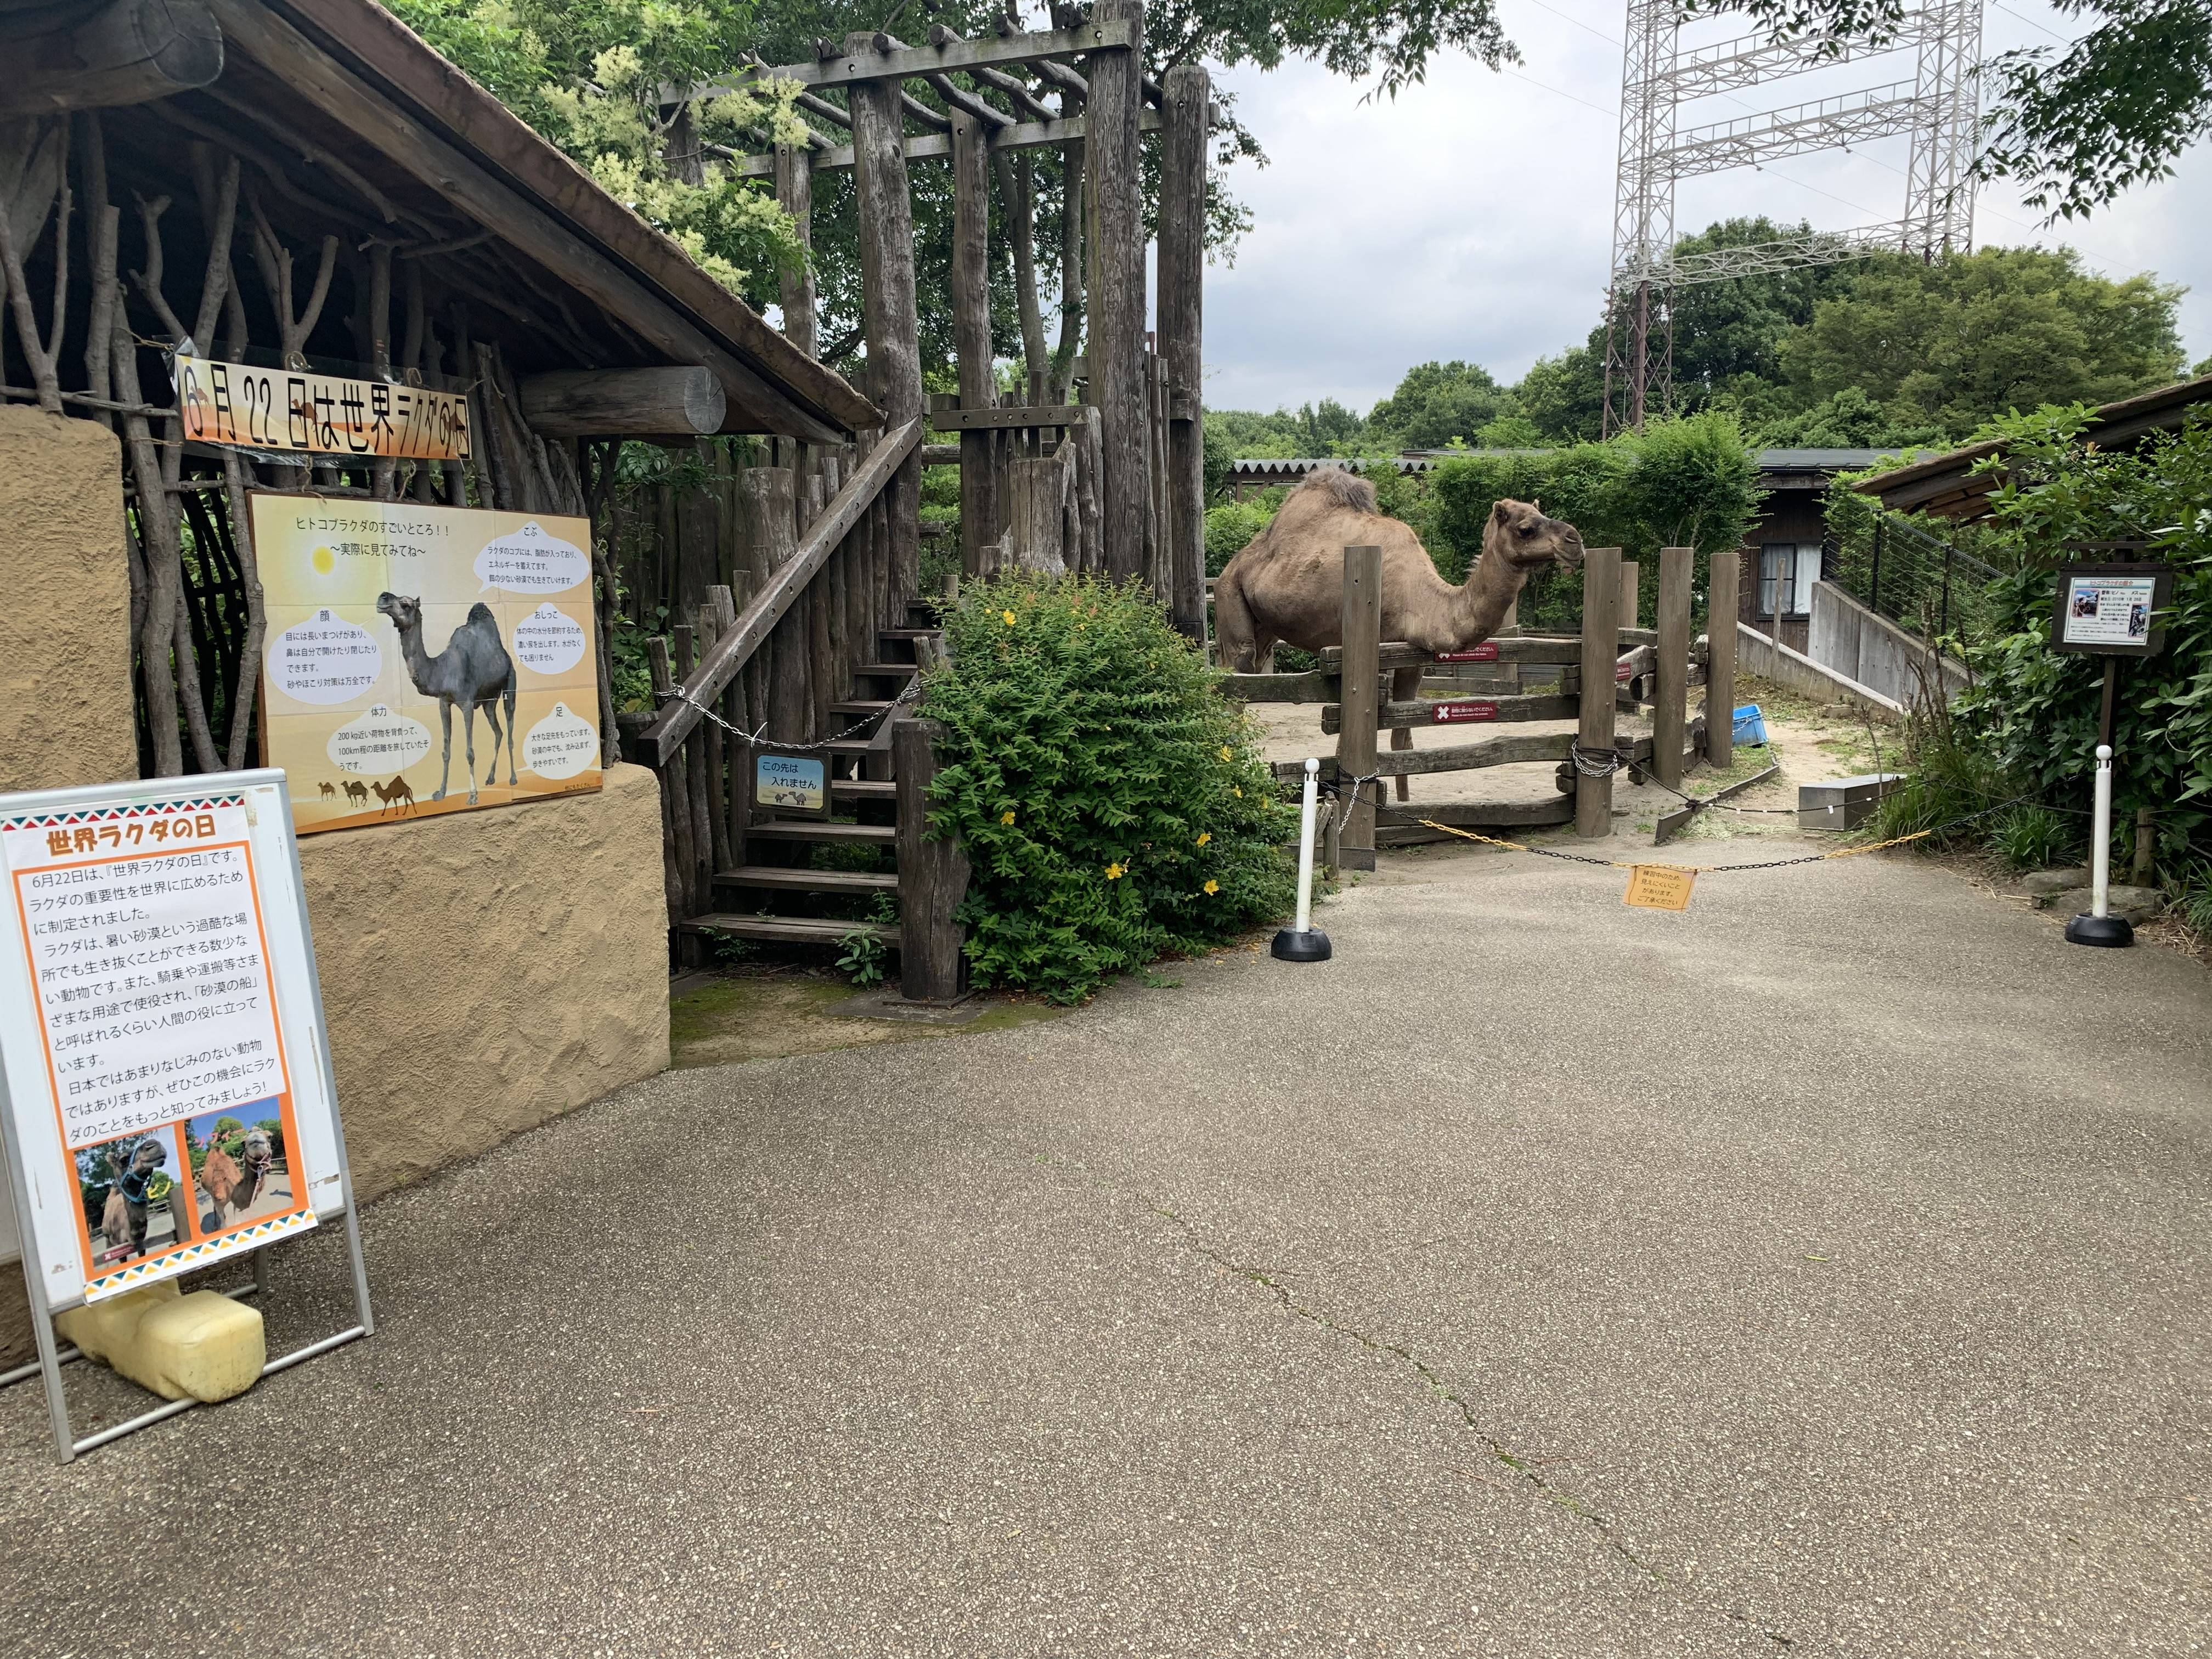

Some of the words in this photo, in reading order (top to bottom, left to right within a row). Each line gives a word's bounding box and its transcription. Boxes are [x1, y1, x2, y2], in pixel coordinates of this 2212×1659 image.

[184, 363, 470, 459] 6月22日は世界ラクダの日
[523, 527, 538, 537] こぶ
[320, 610, 330, 622] 顔
[534, 611, 558, 619] おしっこ
[286, 630, 366, 641] 目には長いまつげがあり、
[286, 645, 377, 658] 鼻は自分で開けたり閉じたり
[286, 663, 319, 673] できます。
[287, 675, 376, 690] 砂やほこり対策は万全です。
[371, 706, 387, 718] 体力
[556, 706, 563, 718] 足
[338, 740, 429, 755] 100km程の距離を旅していたそ
[339, 761, 363, 771] うです。
[763, 761, 799, 773] この先は
[771, 776, 817, 789] 入れません
[46, 814, 216, 857] 世界ラクダの日
[32, 849, 238, 889] 6月22日は、『世界ラクダの日』です。
[1643, 870, 1681, 881] 練習中のため、
[1641, 878, 1681, 889] 見えにくいこと
[29, 870, 244, 913] ラクダの重要性を世界に広めるため
[1642, 888, 1673, 897] があります。
[1638, 895, 1678, 905] ご了承ください
[33, 907, 151, 936] に制定されました。
[43, 912, 247, 958] ラクダは、暑い砂漠という過酷な場
[41, 934, 248, 983] 所でも生き抜くことができる数少な
[46, 952, 260, 1006] い動物です。また、騎乗や運搬等さま
[49, 976, 258, 1029] ざまな用途で使役され、「砂漠の船」
[54, 996, 258, 1052] と呼ばれるくらい人間の役に立って
[58, 1052, 105, 1074] います。
[68, 1038, 262, 1096] 日本ではあまりなじみのない動物
[65, 1057, 275, 1119] ではありますが、ぜひこの機会にラク
[194, 1127, 246, 1148] ソフィー
